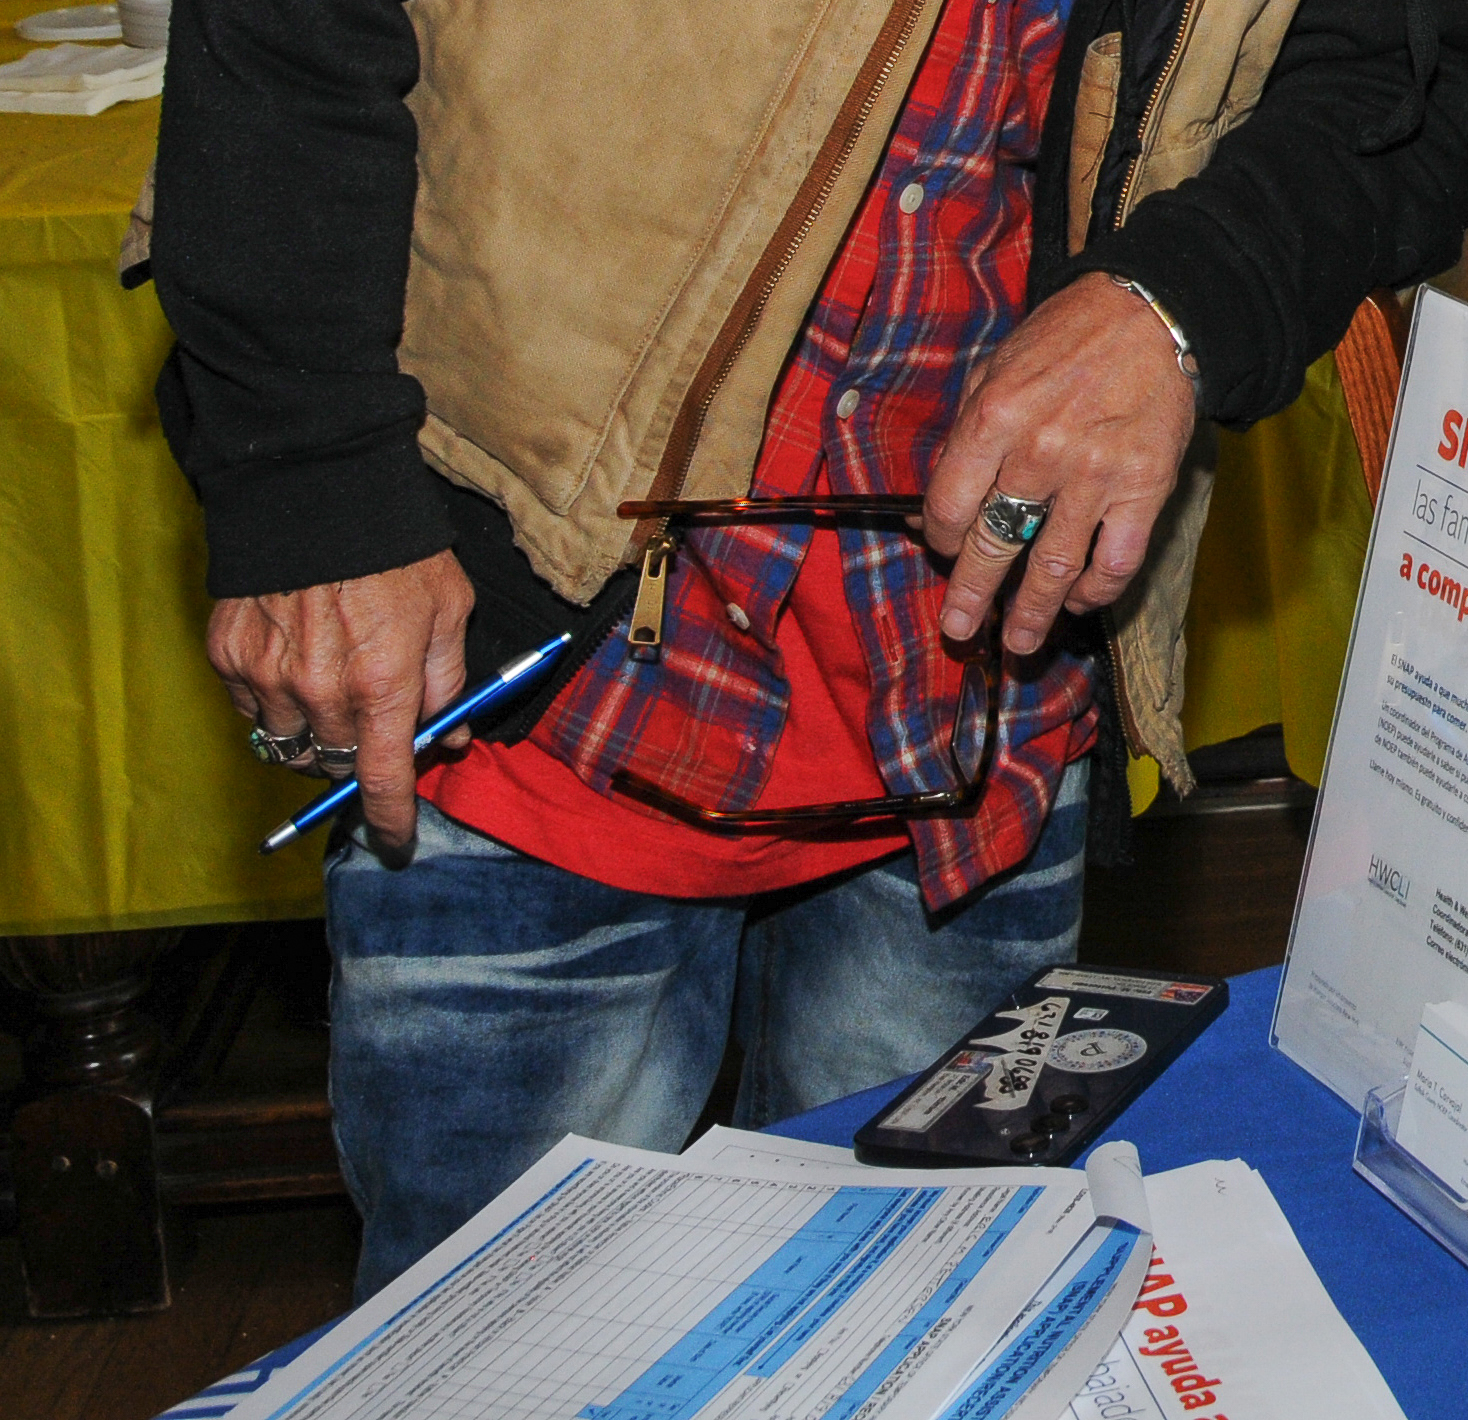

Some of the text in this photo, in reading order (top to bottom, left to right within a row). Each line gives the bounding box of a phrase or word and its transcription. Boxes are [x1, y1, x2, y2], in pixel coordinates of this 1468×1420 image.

[1412, 478, 1438, 526] las
[1399, 552, 1413, 581] a
[1397, 658, 1415, 676] SNAP
[1414, 670, 1434, 690] ayuda
[1433, 682, 1439, 693] a
[1438, 686, 1451, 701] que
[1368, 854, 1411, 900] HWCLI
[928, 1317, 953, 1339] SNAP
[1132, 1244, 1223, 1411] AP ayuda
[868, 1340, 930, 1396] APPLICATION
[1006, 1330, 1065, 1384] NUTRITION
[851, 1402, 877, 1420] REC
